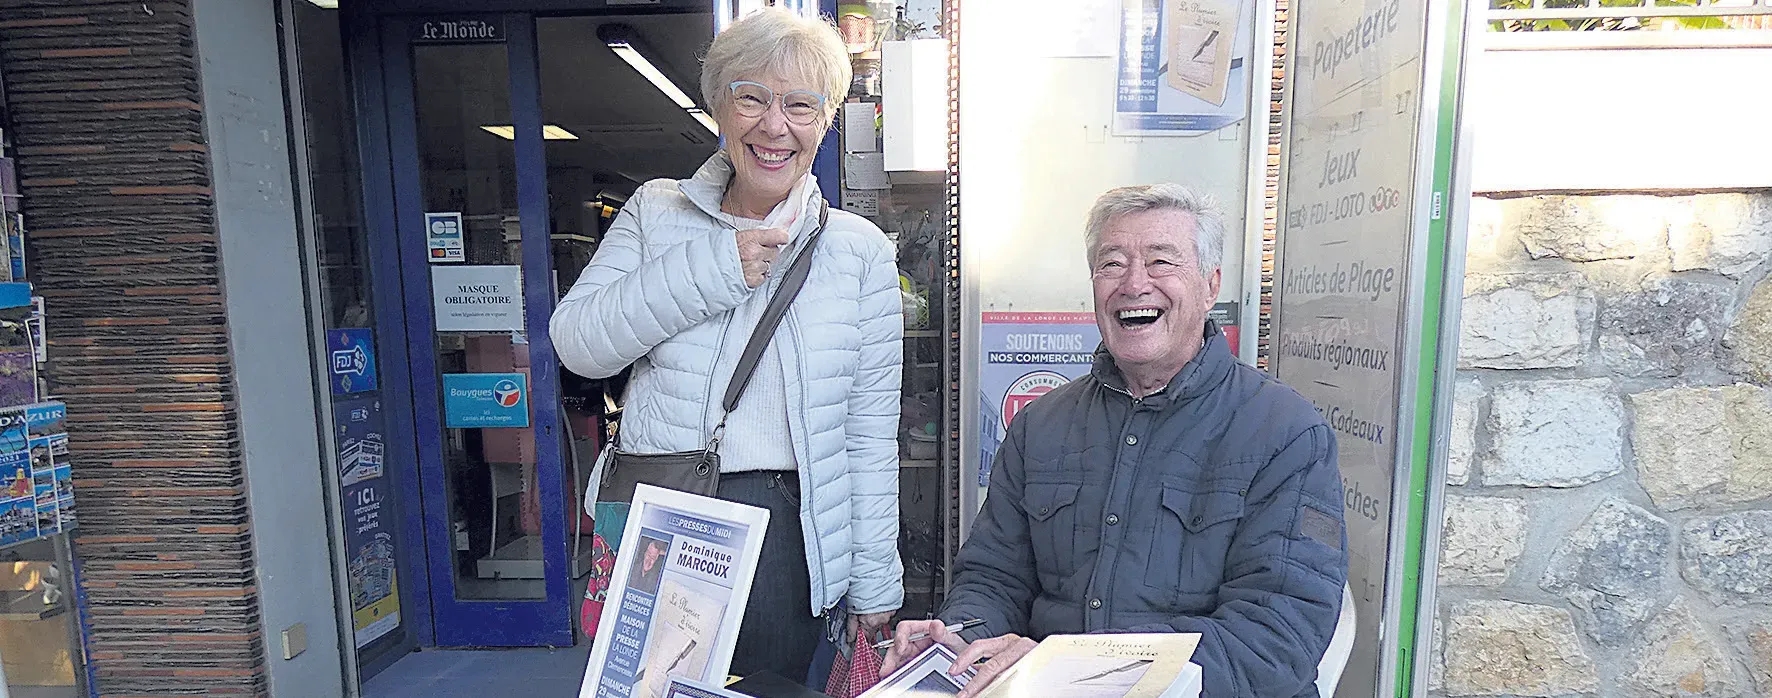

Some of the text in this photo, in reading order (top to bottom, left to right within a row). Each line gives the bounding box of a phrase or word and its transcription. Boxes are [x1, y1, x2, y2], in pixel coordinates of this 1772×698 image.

[422, 21, 495, 39] Le Monde
[1312, 0, 1400, 81] Papeterie
[1119, 79, 1157, 87] DIMANCHE
[1318, 148, 1362, 189] Jeux
[1309, 201, 1329, 226] FDJ
[1334, 191, 1366, 221] LOTO
[431, 220, 457, 235] CB
[1285, 259, 1395, 302] Articles de Plage
[458, 285, 499, 294] MASQUE
[445, 296, 511, 304] OBLIGATOIRE
[1006, 333, 1083, 351] SOUTENONS
[990, 353, 1013, 363] NOS
[1281, 333, 1388, 371] Produits régionaux
[336, 355, 352, 369] FDJ
[450, 388, 493, 399] Bouygues
[1330, 406, 1385, 445] Cadeaux
[357, 487, 375, 506] ICI
[1343, 477, 1380, 521] îches
[354, 502, 381, 516] retrouvez
[681, 541, 732, 563] Dominique
[676, 553, 730, 579] MARCOUX
[622, 600, 650, 617] DÉDICACES
[625, 592, 653, 608] RENCONTRE
[620, 614, 646, 630] MAISON
[621, 625, 639, 639] DE LA
[615, 633, 641, 650] PRESSE
[611, 643, 639, 660] LA LONDE
[598, 685, 607, 697] 29
[600, 675, 631, 697] DIMANCHE
